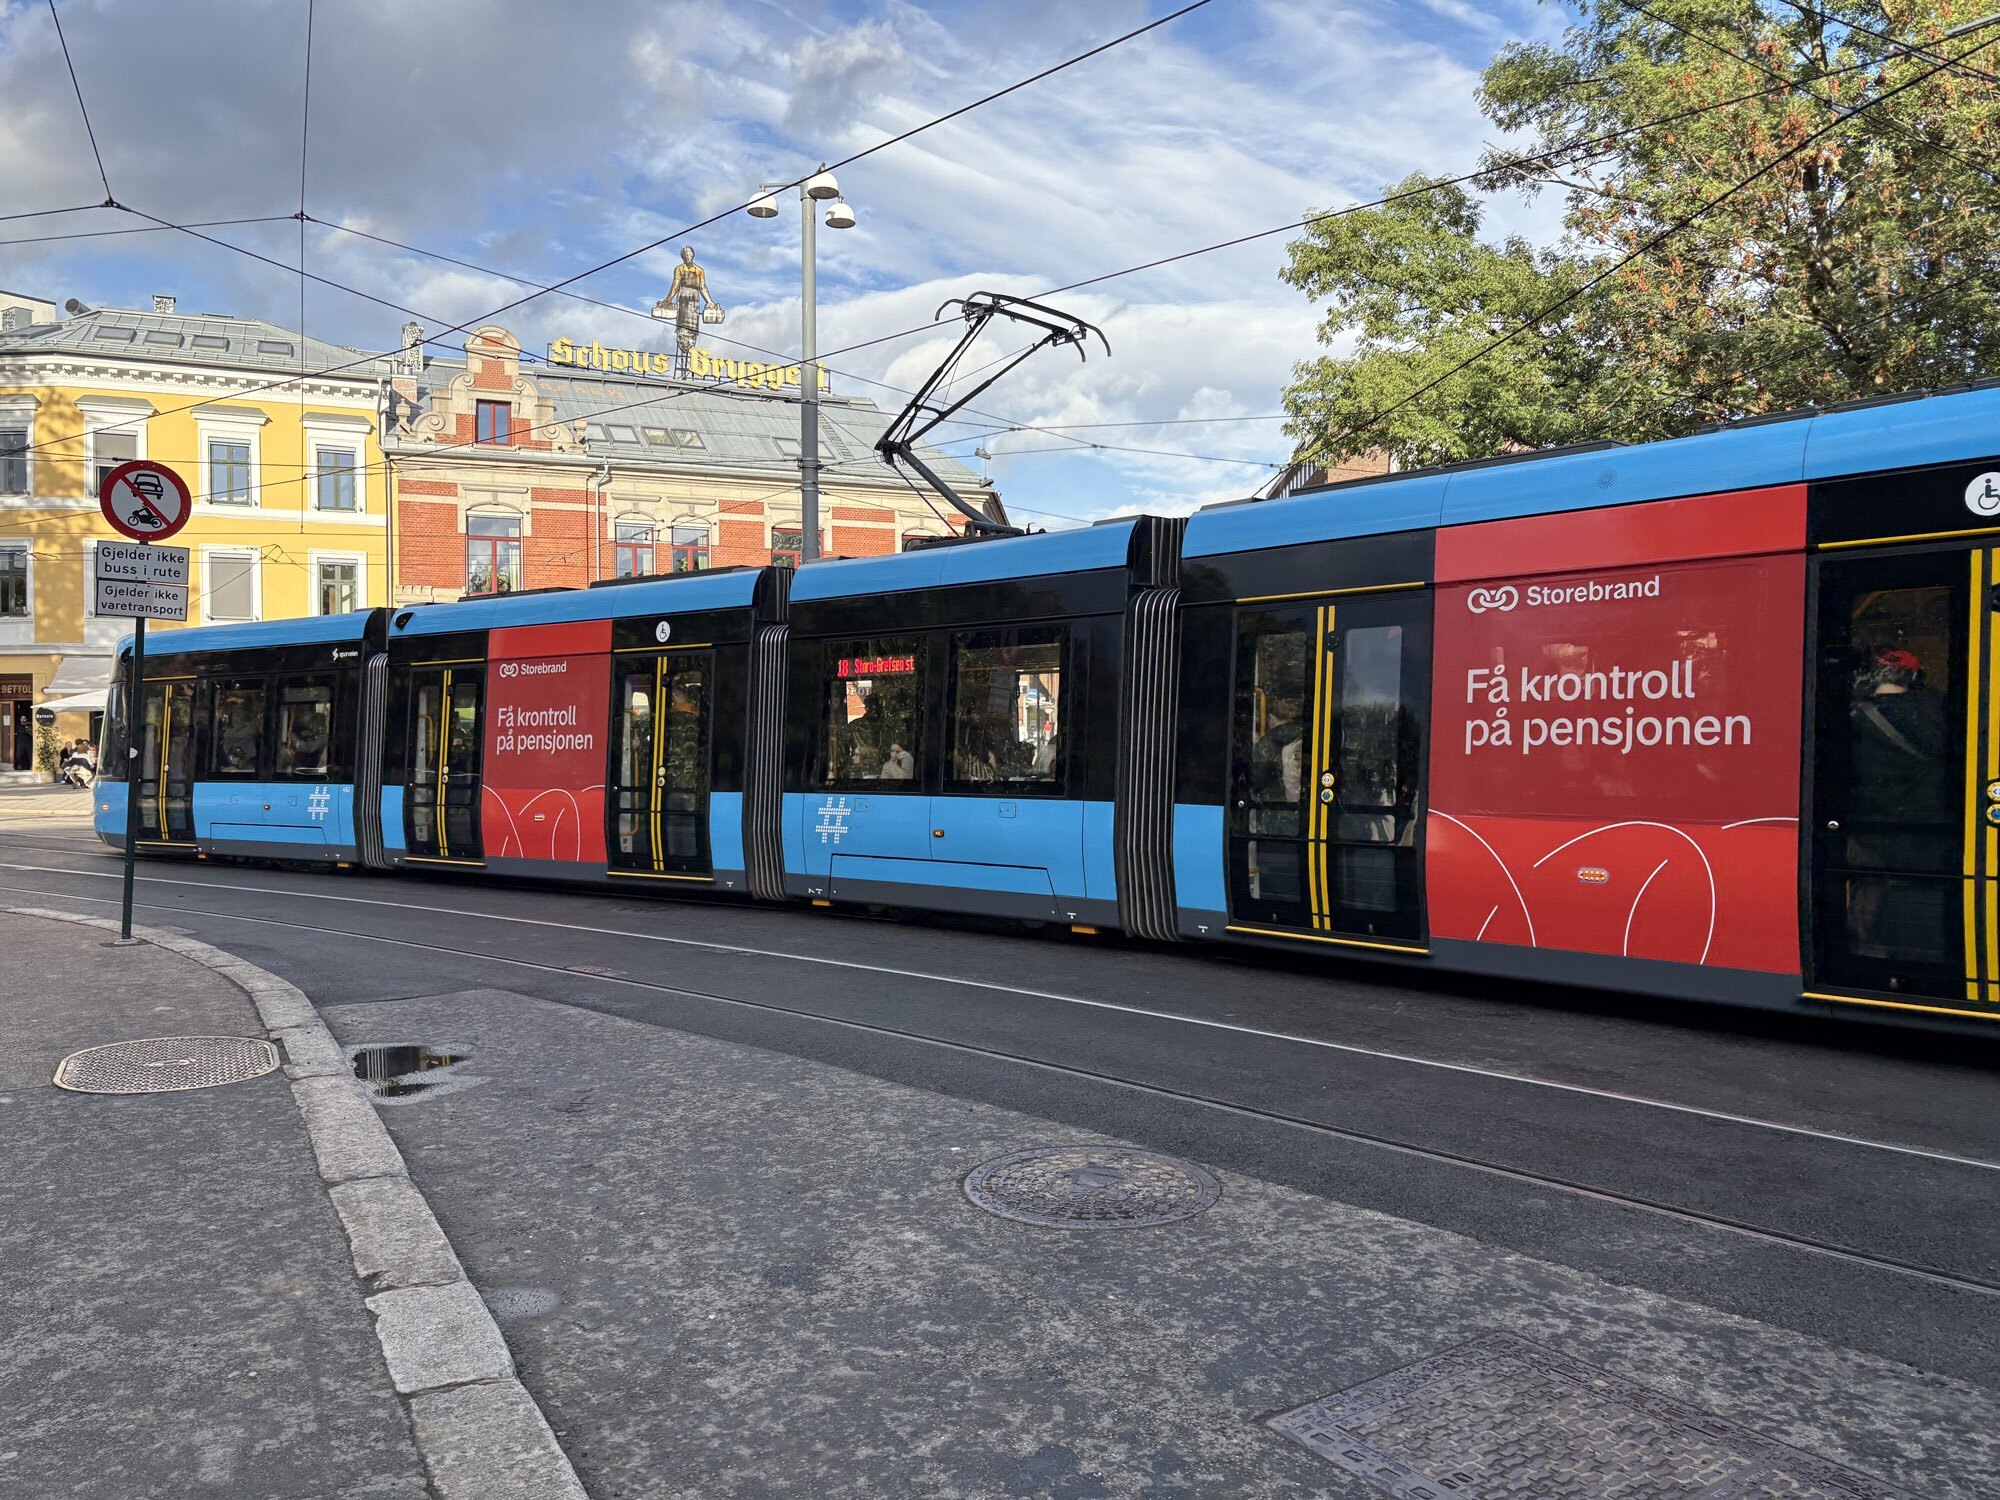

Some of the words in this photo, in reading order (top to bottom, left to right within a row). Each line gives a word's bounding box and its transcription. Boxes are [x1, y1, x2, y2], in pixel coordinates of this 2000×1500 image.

[551, 336, 670, 374] Schous
[688, 346, 827, 390] Bryggei
[101, 546, 152, 561] Gjelder
[157, 551, 185, 564] ikke
[104, 562, 138, 574] buss
[143, 564, 147, 575] i
[153, 567, 181, 577] rute
[104, 585, 150, 598] Gjelder
[154, 589, 179, 600] ikke
[1526, 575, 1661, 607] Storebrand
[101, 601, 184, 616] varetransport
[520, 661, 567, 676] Storebrand
[837, 659, 849, 678] 18
[1466, 664, 1510, 703] Få
[1521, 659, 1695, 702] krontroll
[497, 705, 515, 728] Få
[517, 705, 577, 727] krontroll
[1465, 706, 1512, 755] på
[1523, 706, 1751, 755] pensjonen
[496, 729, 515, 755] på
[517, 729, 593, 755] pensjonen
